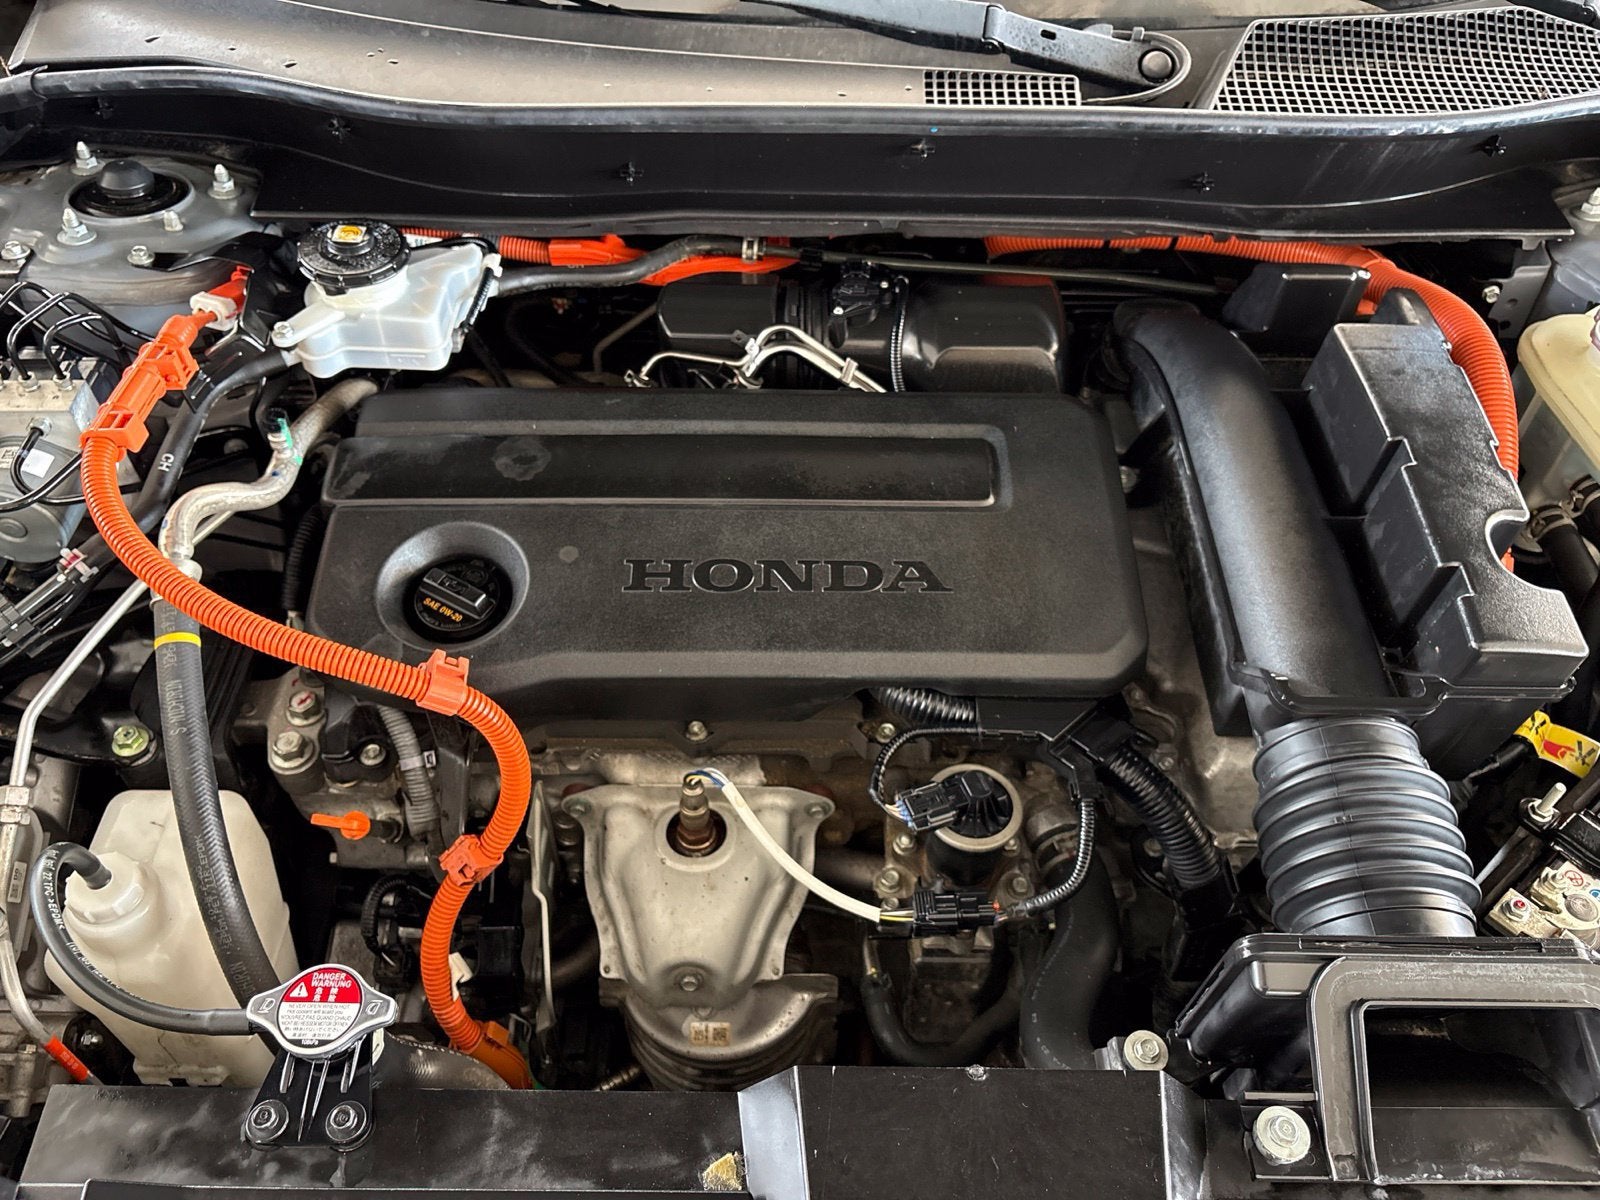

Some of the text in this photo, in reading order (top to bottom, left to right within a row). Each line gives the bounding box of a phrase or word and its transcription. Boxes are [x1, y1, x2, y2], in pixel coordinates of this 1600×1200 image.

[158, 453, 174, 472] CH
[622, 558, 953, 593] HONDA
[423, 597, 441, 610] SAE
[439, 605, 463, 623] 0W-20
[311, 979, 352, 988] WARNUNG
[312, 972, 347, 981] DANGER
